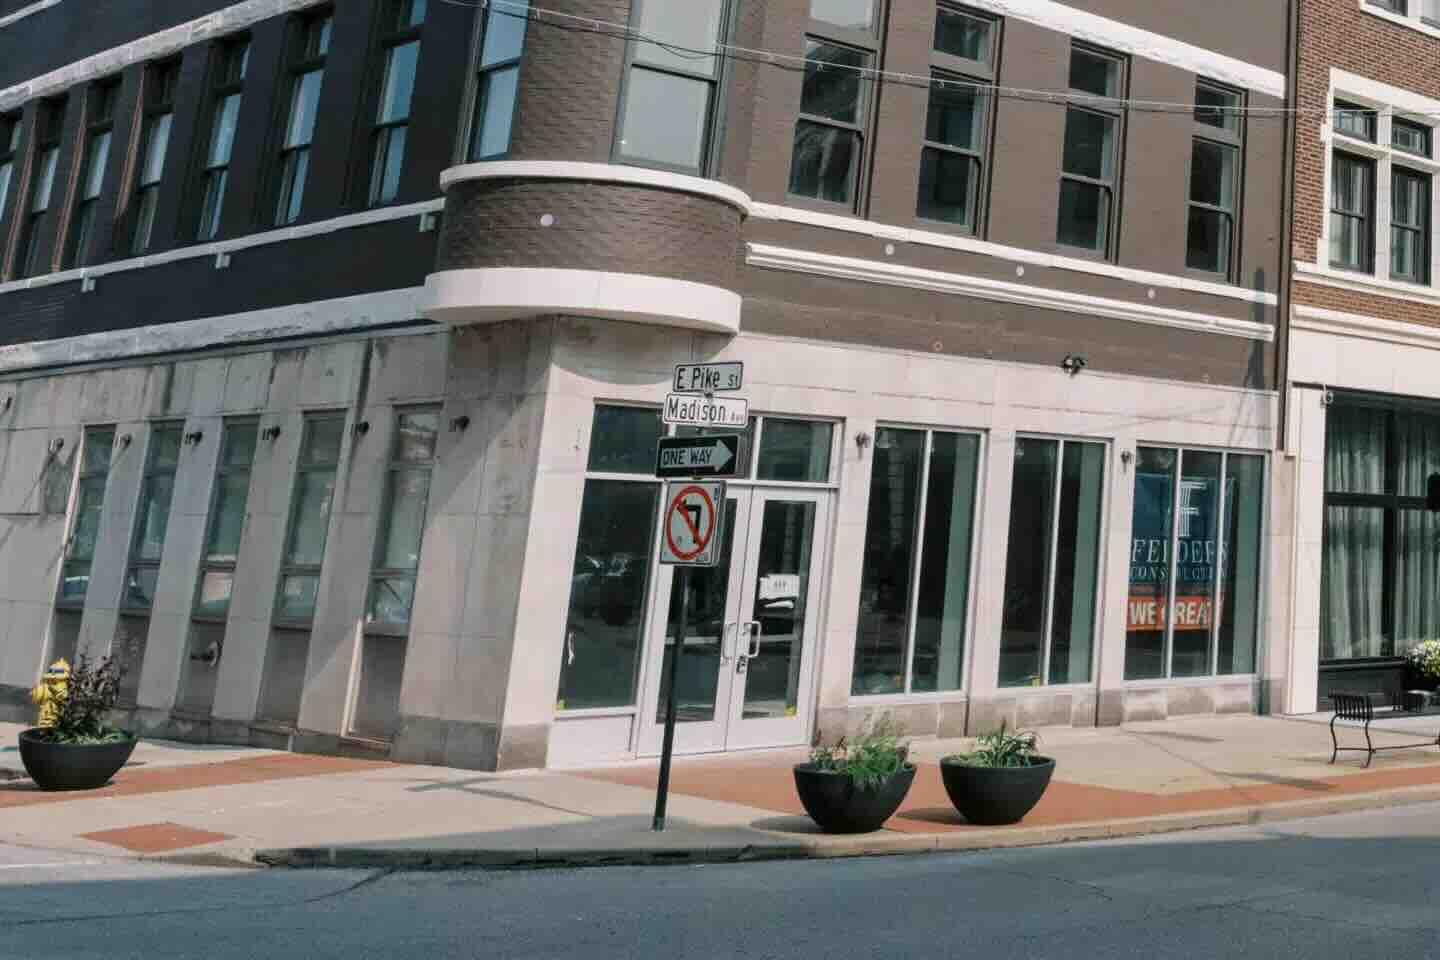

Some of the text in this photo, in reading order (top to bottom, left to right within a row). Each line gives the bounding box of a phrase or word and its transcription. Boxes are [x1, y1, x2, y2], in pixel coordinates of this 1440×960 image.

[677, 367, 686, 389] E
[692, 367, 721, 388] Pike
[668, 397, 726, 422] Madison
[663, 448, 712, 465] ONE WAY
[1129, 601, 1156, 624] WE
